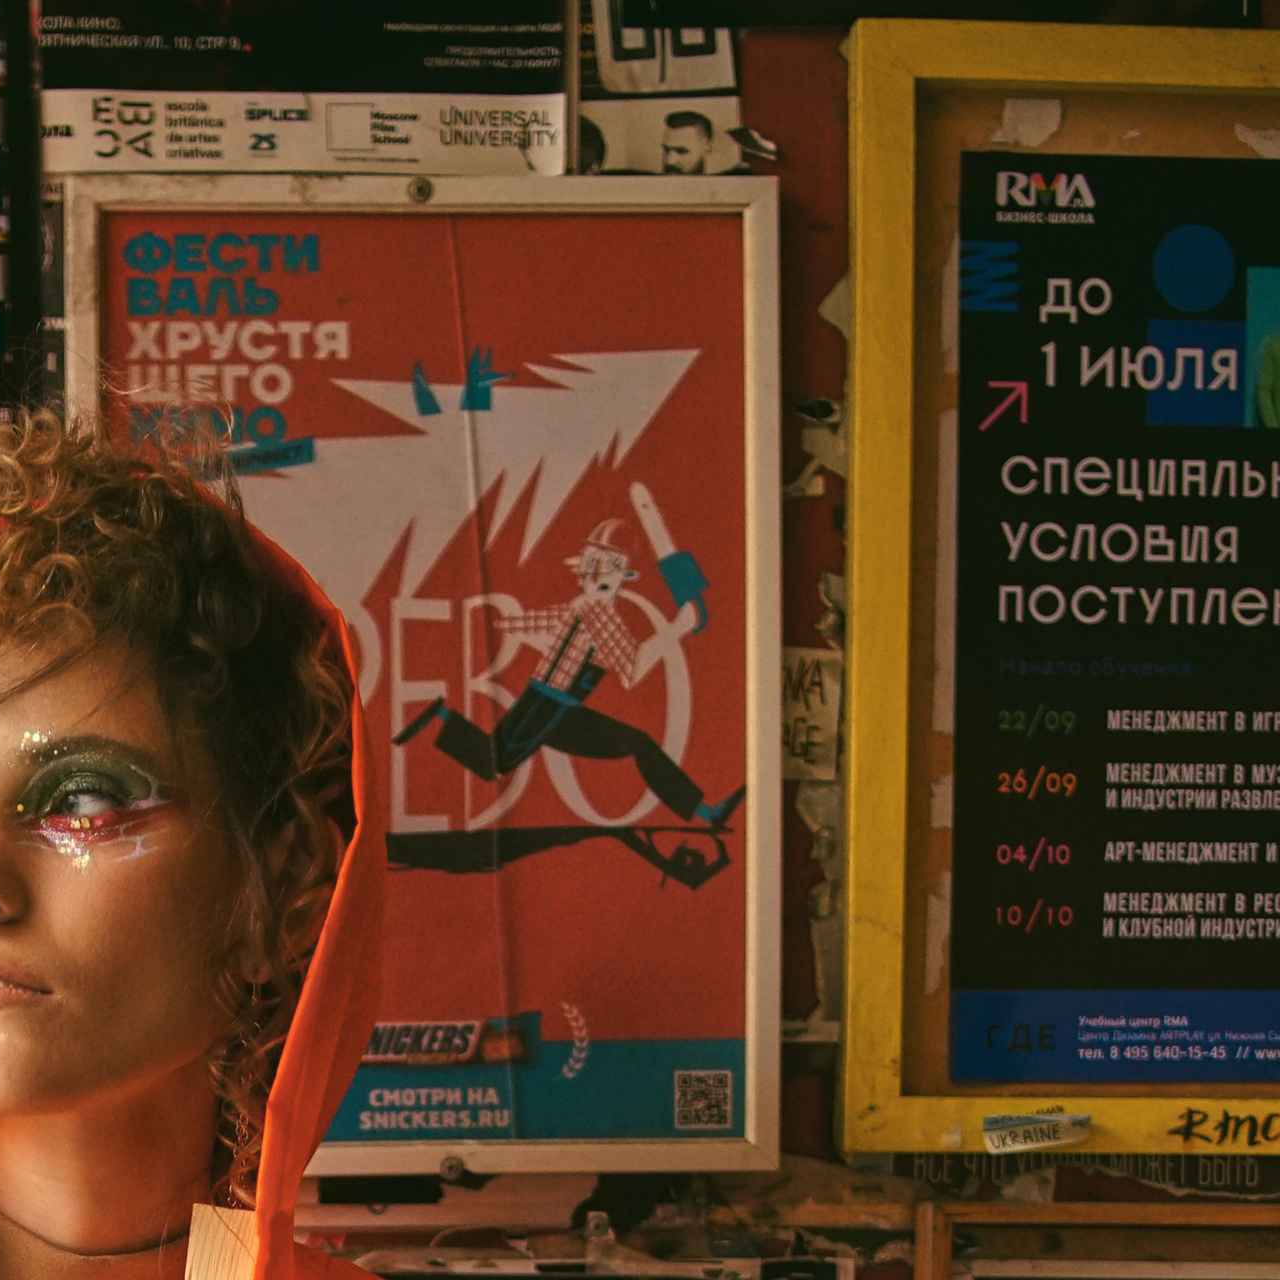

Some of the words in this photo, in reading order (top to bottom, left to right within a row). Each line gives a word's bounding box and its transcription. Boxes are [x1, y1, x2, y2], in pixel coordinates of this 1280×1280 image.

[244, 108, 310, 121] SPLICE
[438, 107, 551, 127] UNIVERSAL
[438, 129, 559, 148] UNIVERSITY
[995, 171, 1096, 207] RMA
[995, 210, 1096, 226] БИЗНЕС-ШКОЛА
[123, 232, 321, 273] ФЕСТИ
[126, 276, 280, 317] ВАЛЬ
[1039, 277, 1113, 325] ДО
[125, 320, 353, 361] ХРУСТЯ
[1039, 341, 1058, 389] 1
[1079, 345, 1239, 392] ИЮЛЯ
[126, 362, 294, 404] ЩЕГО
[1000, 521, 1239, 564] УСЛОВИЯ
[997, 704, 1078, 737] 22/09
[1106, 709, 1229, 732] МЕНЕДЖМЕНТ
[1234, 711, 1246, 732] В
[997, 765, 1078, 800] 26/09
[1106, 762, 1227, 785] МЕНЕДЖМЕНТ
[1233, 763, 1246, 785] В
[1105, 788, 1118, 809] И
[1121, 788, 1218, 811] ИНДУСТРИИ
[996, 837, 1071, 871] 04/10
[1104, 840, 1259, 865] АРТ-МЕНЕДЖМЕНТ
[1265, 842, 1278, 863] И
[995, 899, 1073, 932] 10/10
[1103, 892, 1227, 914] МЕНЕДЖМЕНТ
[1234, 893, 1247, 914] В
[1102, 917, 1115, 939] И
[1118, 914, 1197, 939] КЛУБНОЙ
[1077, 1014, 1128, 1027] Учебный
[1128, 1016, 1162, 1029] центр
[1163, 1015, 1189, 1027] RMA
[366, 1021, 477, 1056] NICKERS
[986, 1024, 1057, 1053] ГДЕ
[1077, 1030, 1110, 1043] Центр
[1077, 1046, 1105, 1060] тел.
[1109, 1045, 1120, 1060] 8
[1122, 1045, 1149, 1060] 495
[1152, 1045, 1227, 1060] 640-15-45
[368, 1088, 462, 1107] СМОТРИ
[467, 1087, 501, 1106] НА
[359, 1109, 511, 1130] SNICKERS.RU
[988, 1122, 1062, 1150] UKRAINE
